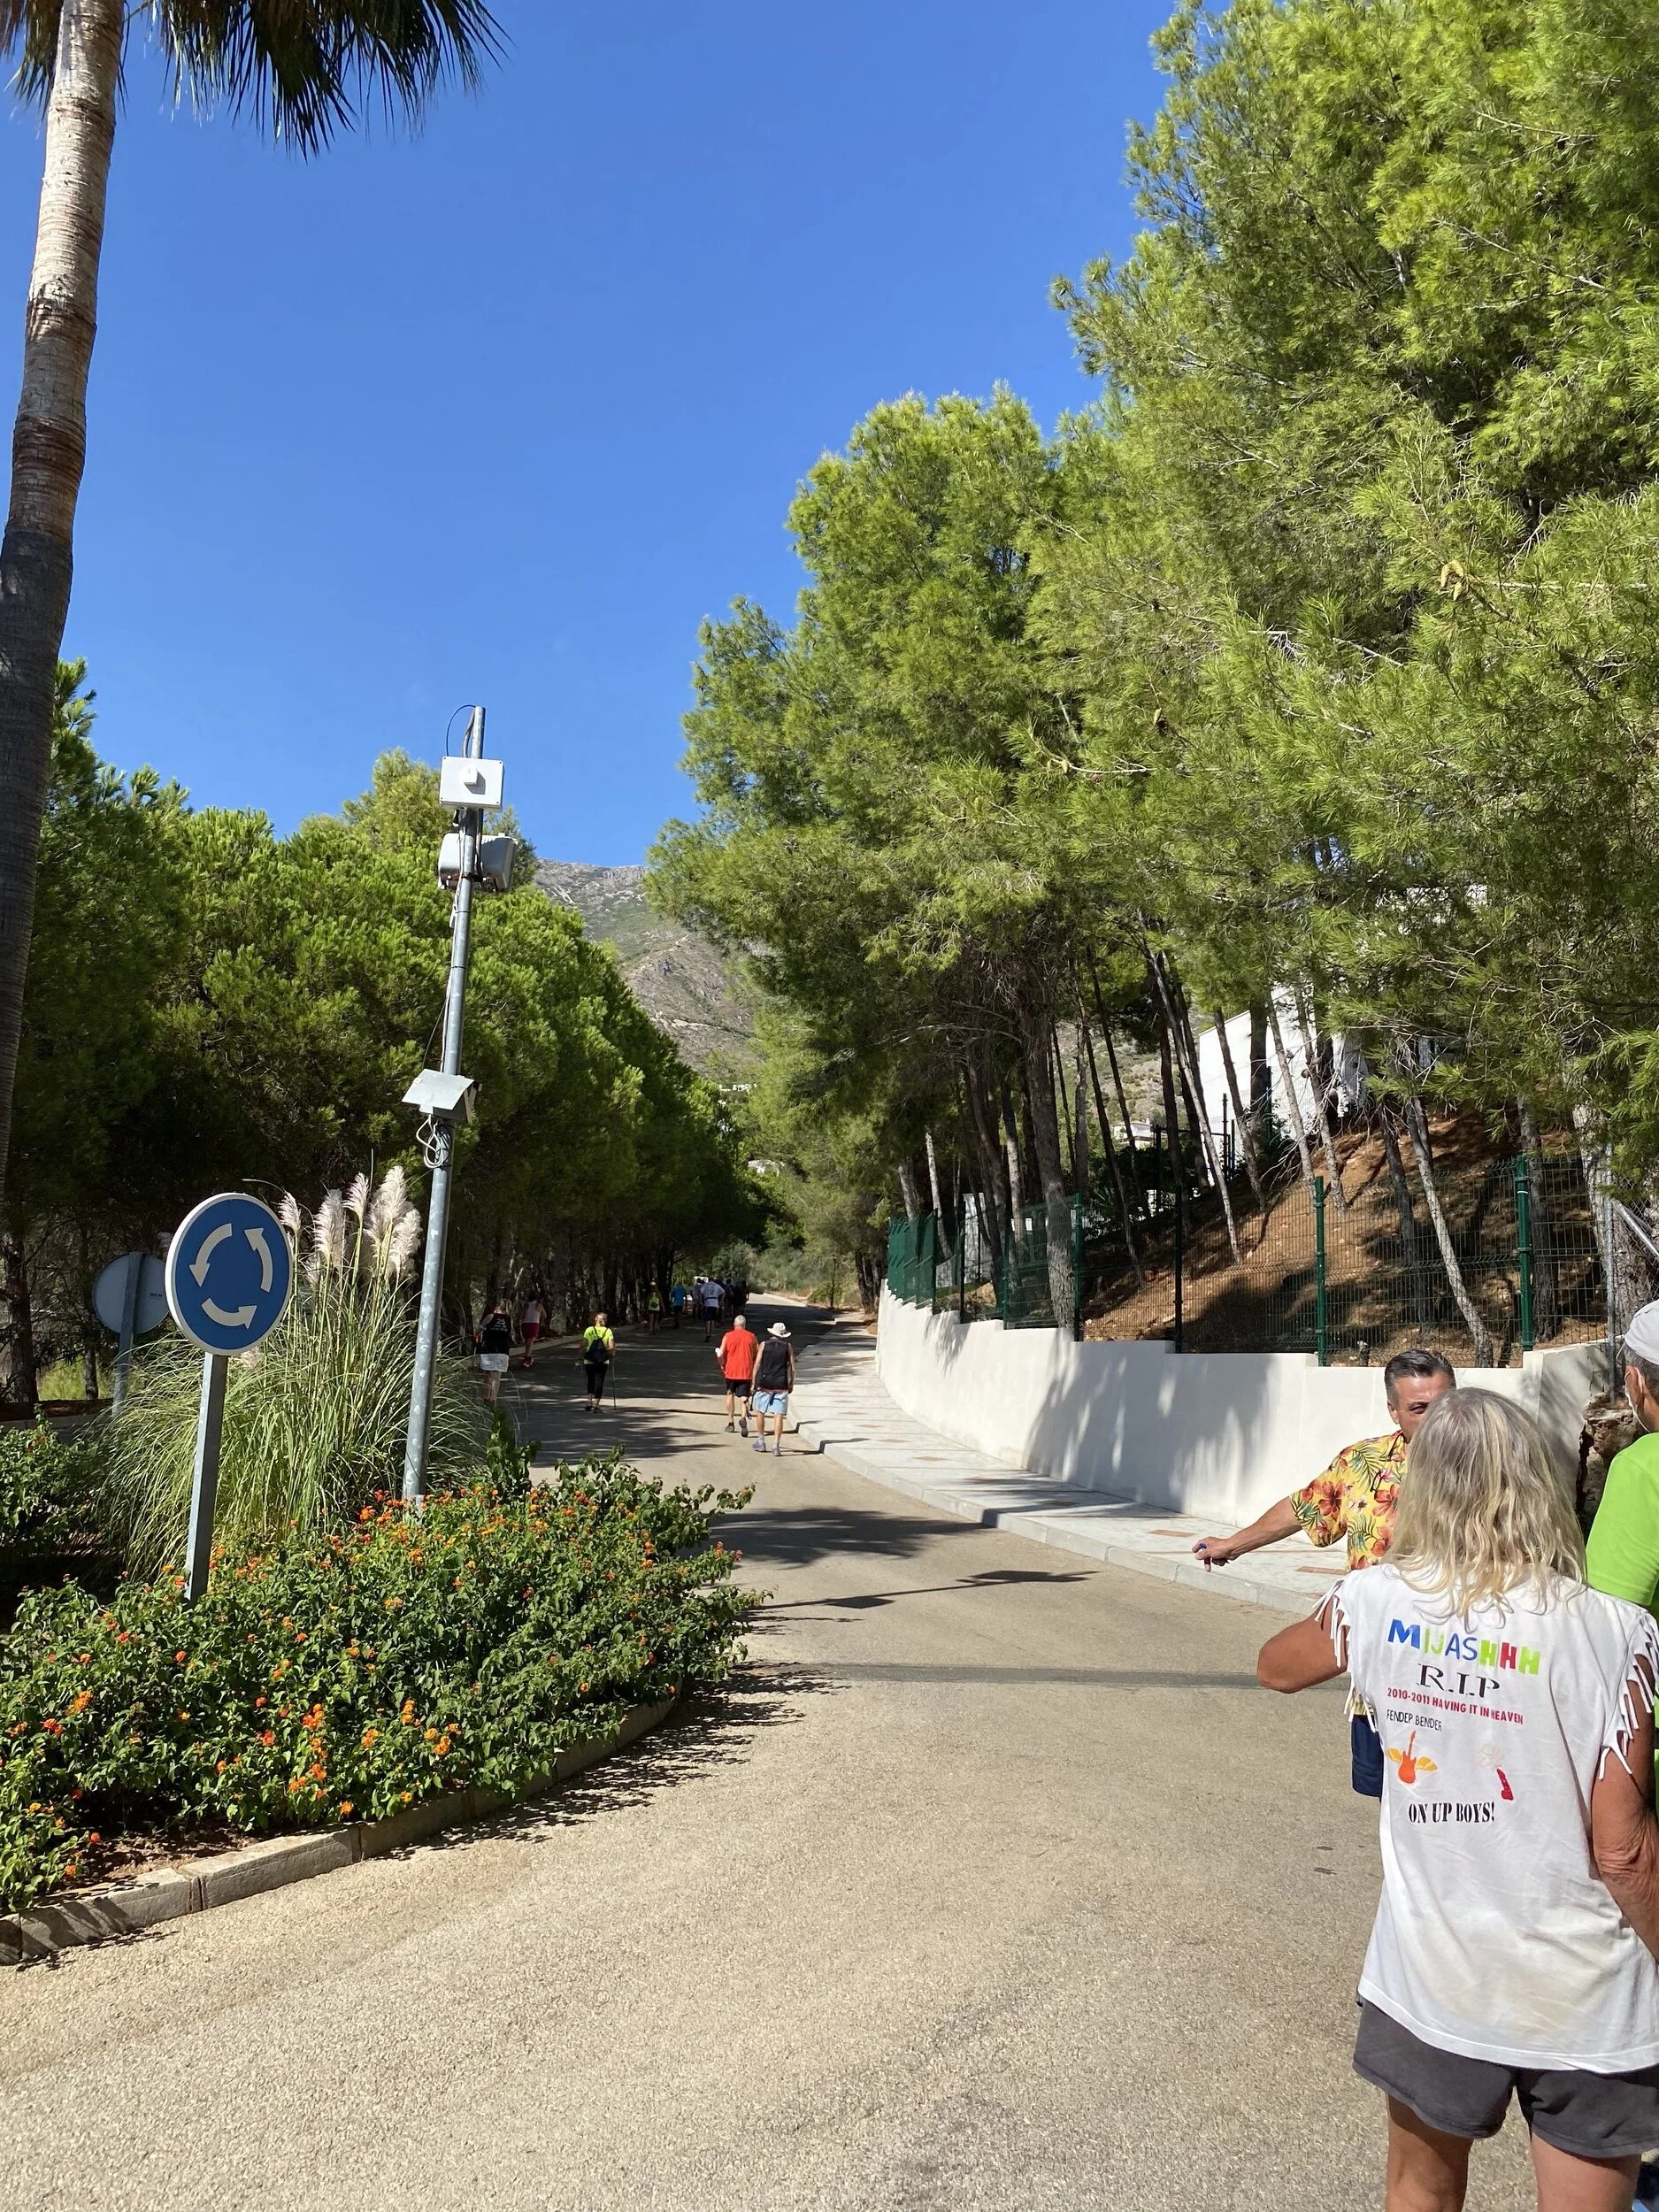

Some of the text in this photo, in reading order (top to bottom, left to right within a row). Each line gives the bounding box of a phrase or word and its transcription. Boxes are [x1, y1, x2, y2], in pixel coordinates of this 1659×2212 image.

[1387, 1618, 1540, 1675] MIJASHHH
[1416, 1663, 1500, 1698] R.I.P
[1387, 1687, 1524, 1724] 2010-2011 HAVING IT IN HEAVEN
[1415, 1716, 1442, 1732] BENDER
[1409, 1801, 1495, 1823] ON UP BOYS!
